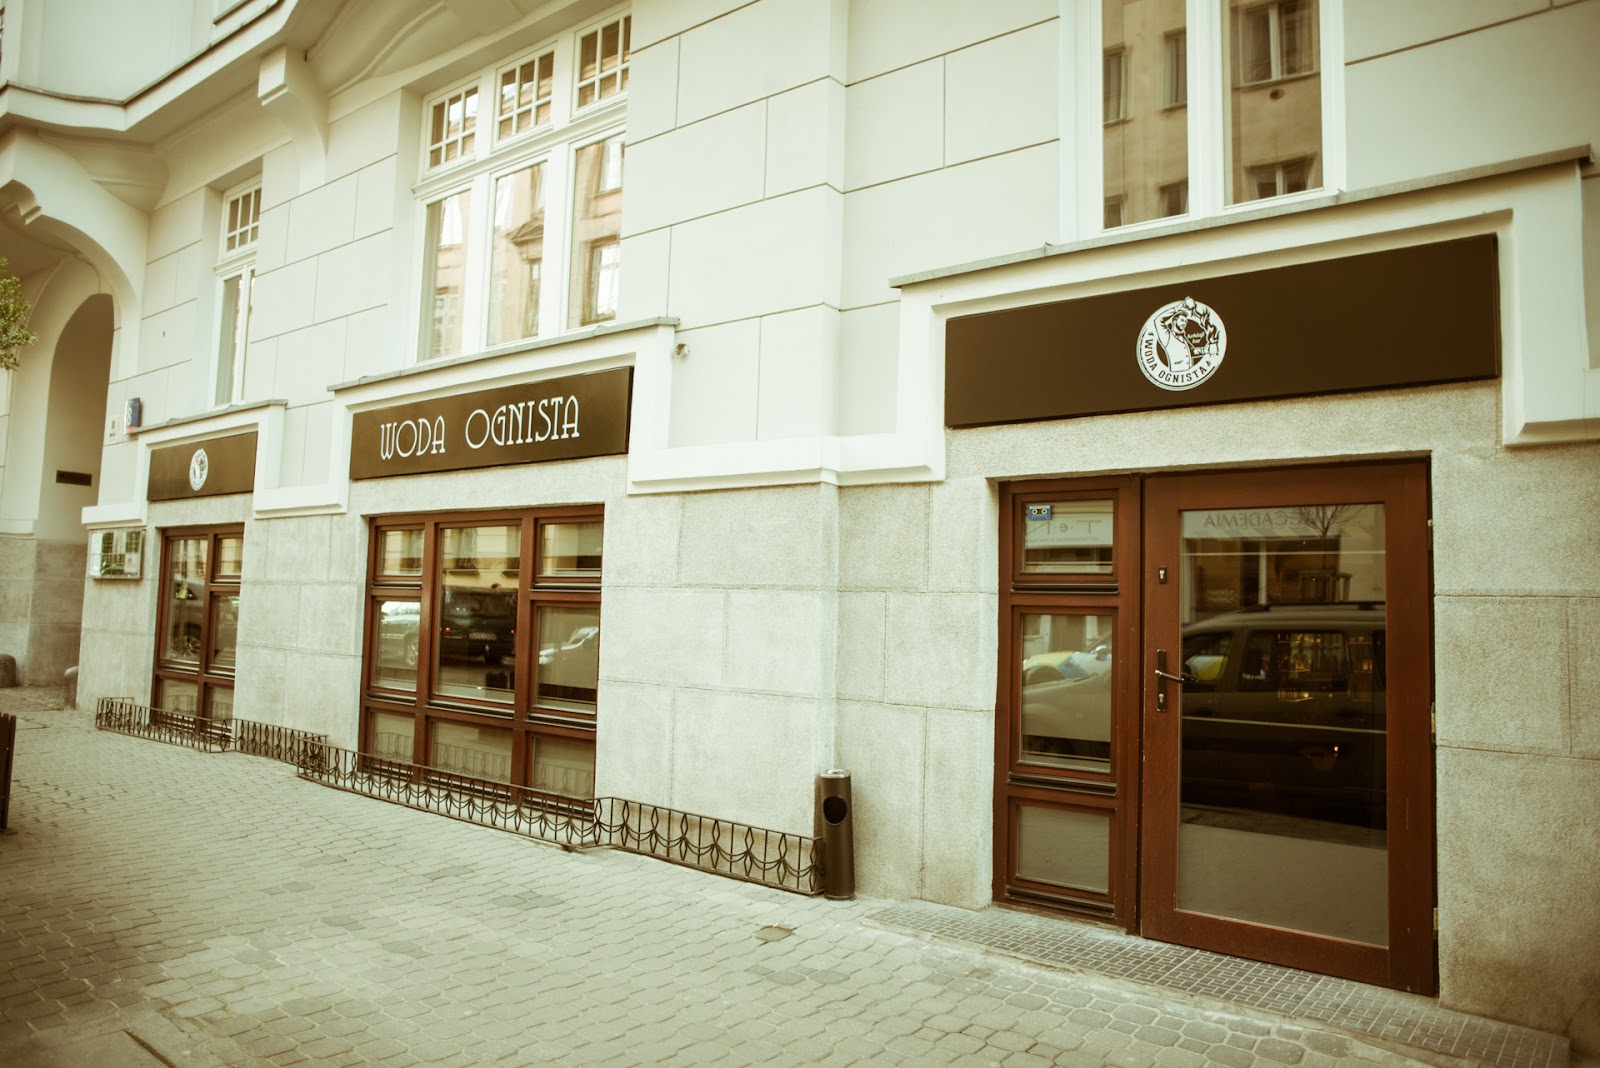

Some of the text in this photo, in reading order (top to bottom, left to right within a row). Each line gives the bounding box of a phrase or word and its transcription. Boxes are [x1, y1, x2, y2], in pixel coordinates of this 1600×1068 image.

[1145, 339, 1207, 383] WODA OGNISTA
[380, 395, 580, 460] WODA OGNISTA
